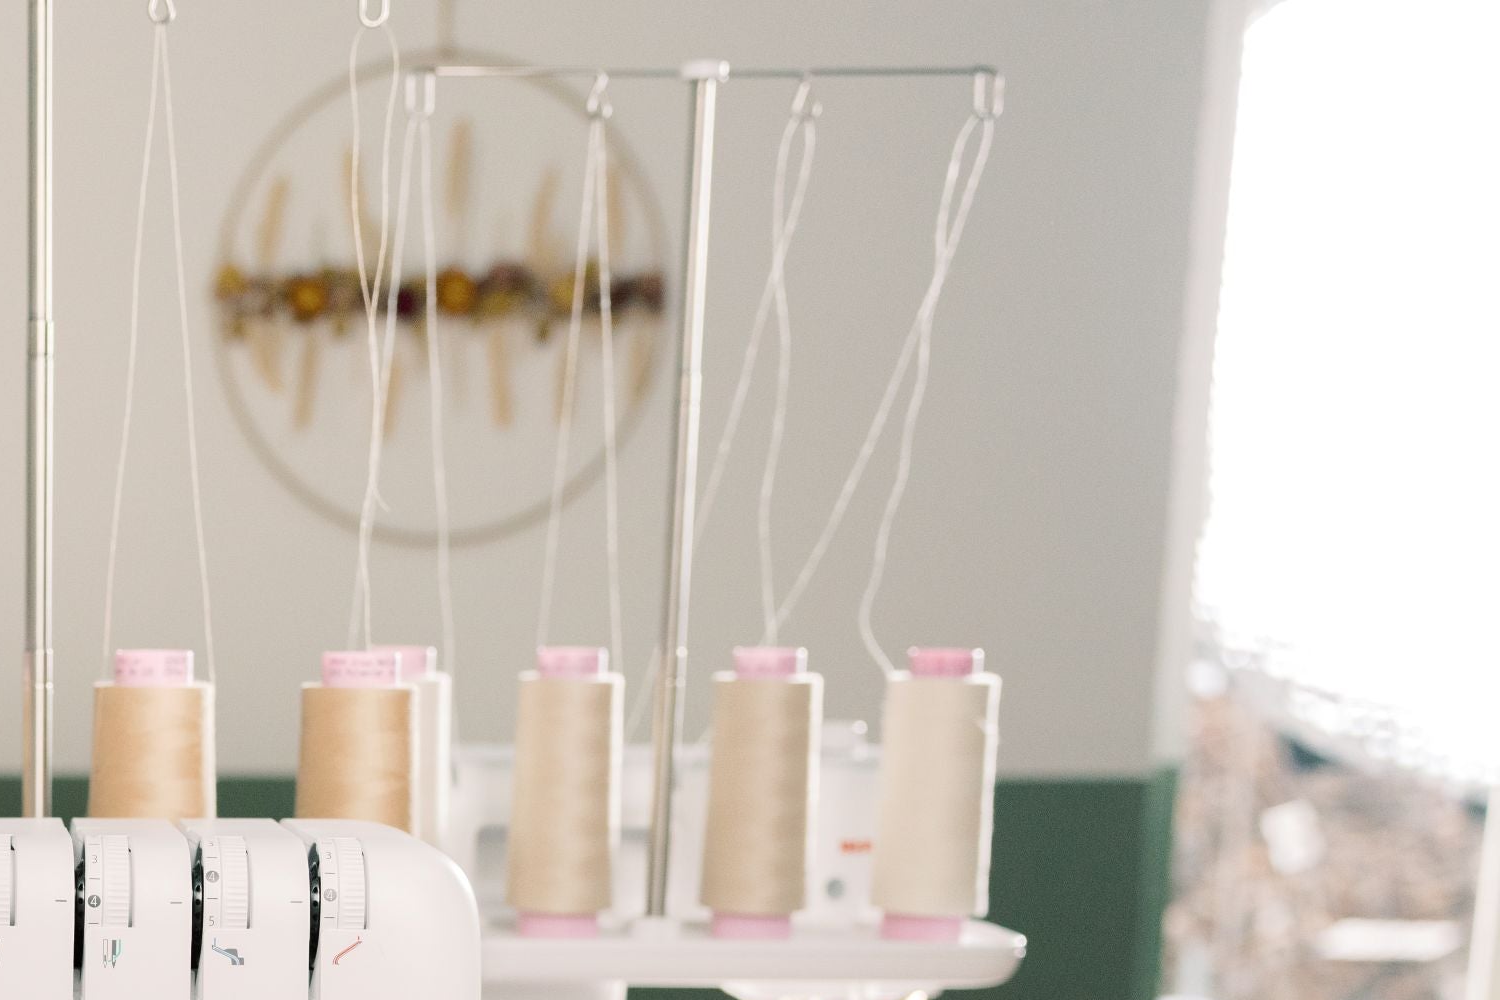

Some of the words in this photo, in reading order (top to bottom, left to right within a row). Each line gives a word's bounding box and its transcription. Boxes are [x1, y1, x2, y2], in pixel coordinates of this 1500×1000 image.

[91, 854, 98, 864] 3
[325, 851, 332, 860] 3
[207, 871, 217, 882] 4
[325, 889, 335, 901] 4
[89, 895, 99, 907] 4
[209, 915, 215, 926] 5
